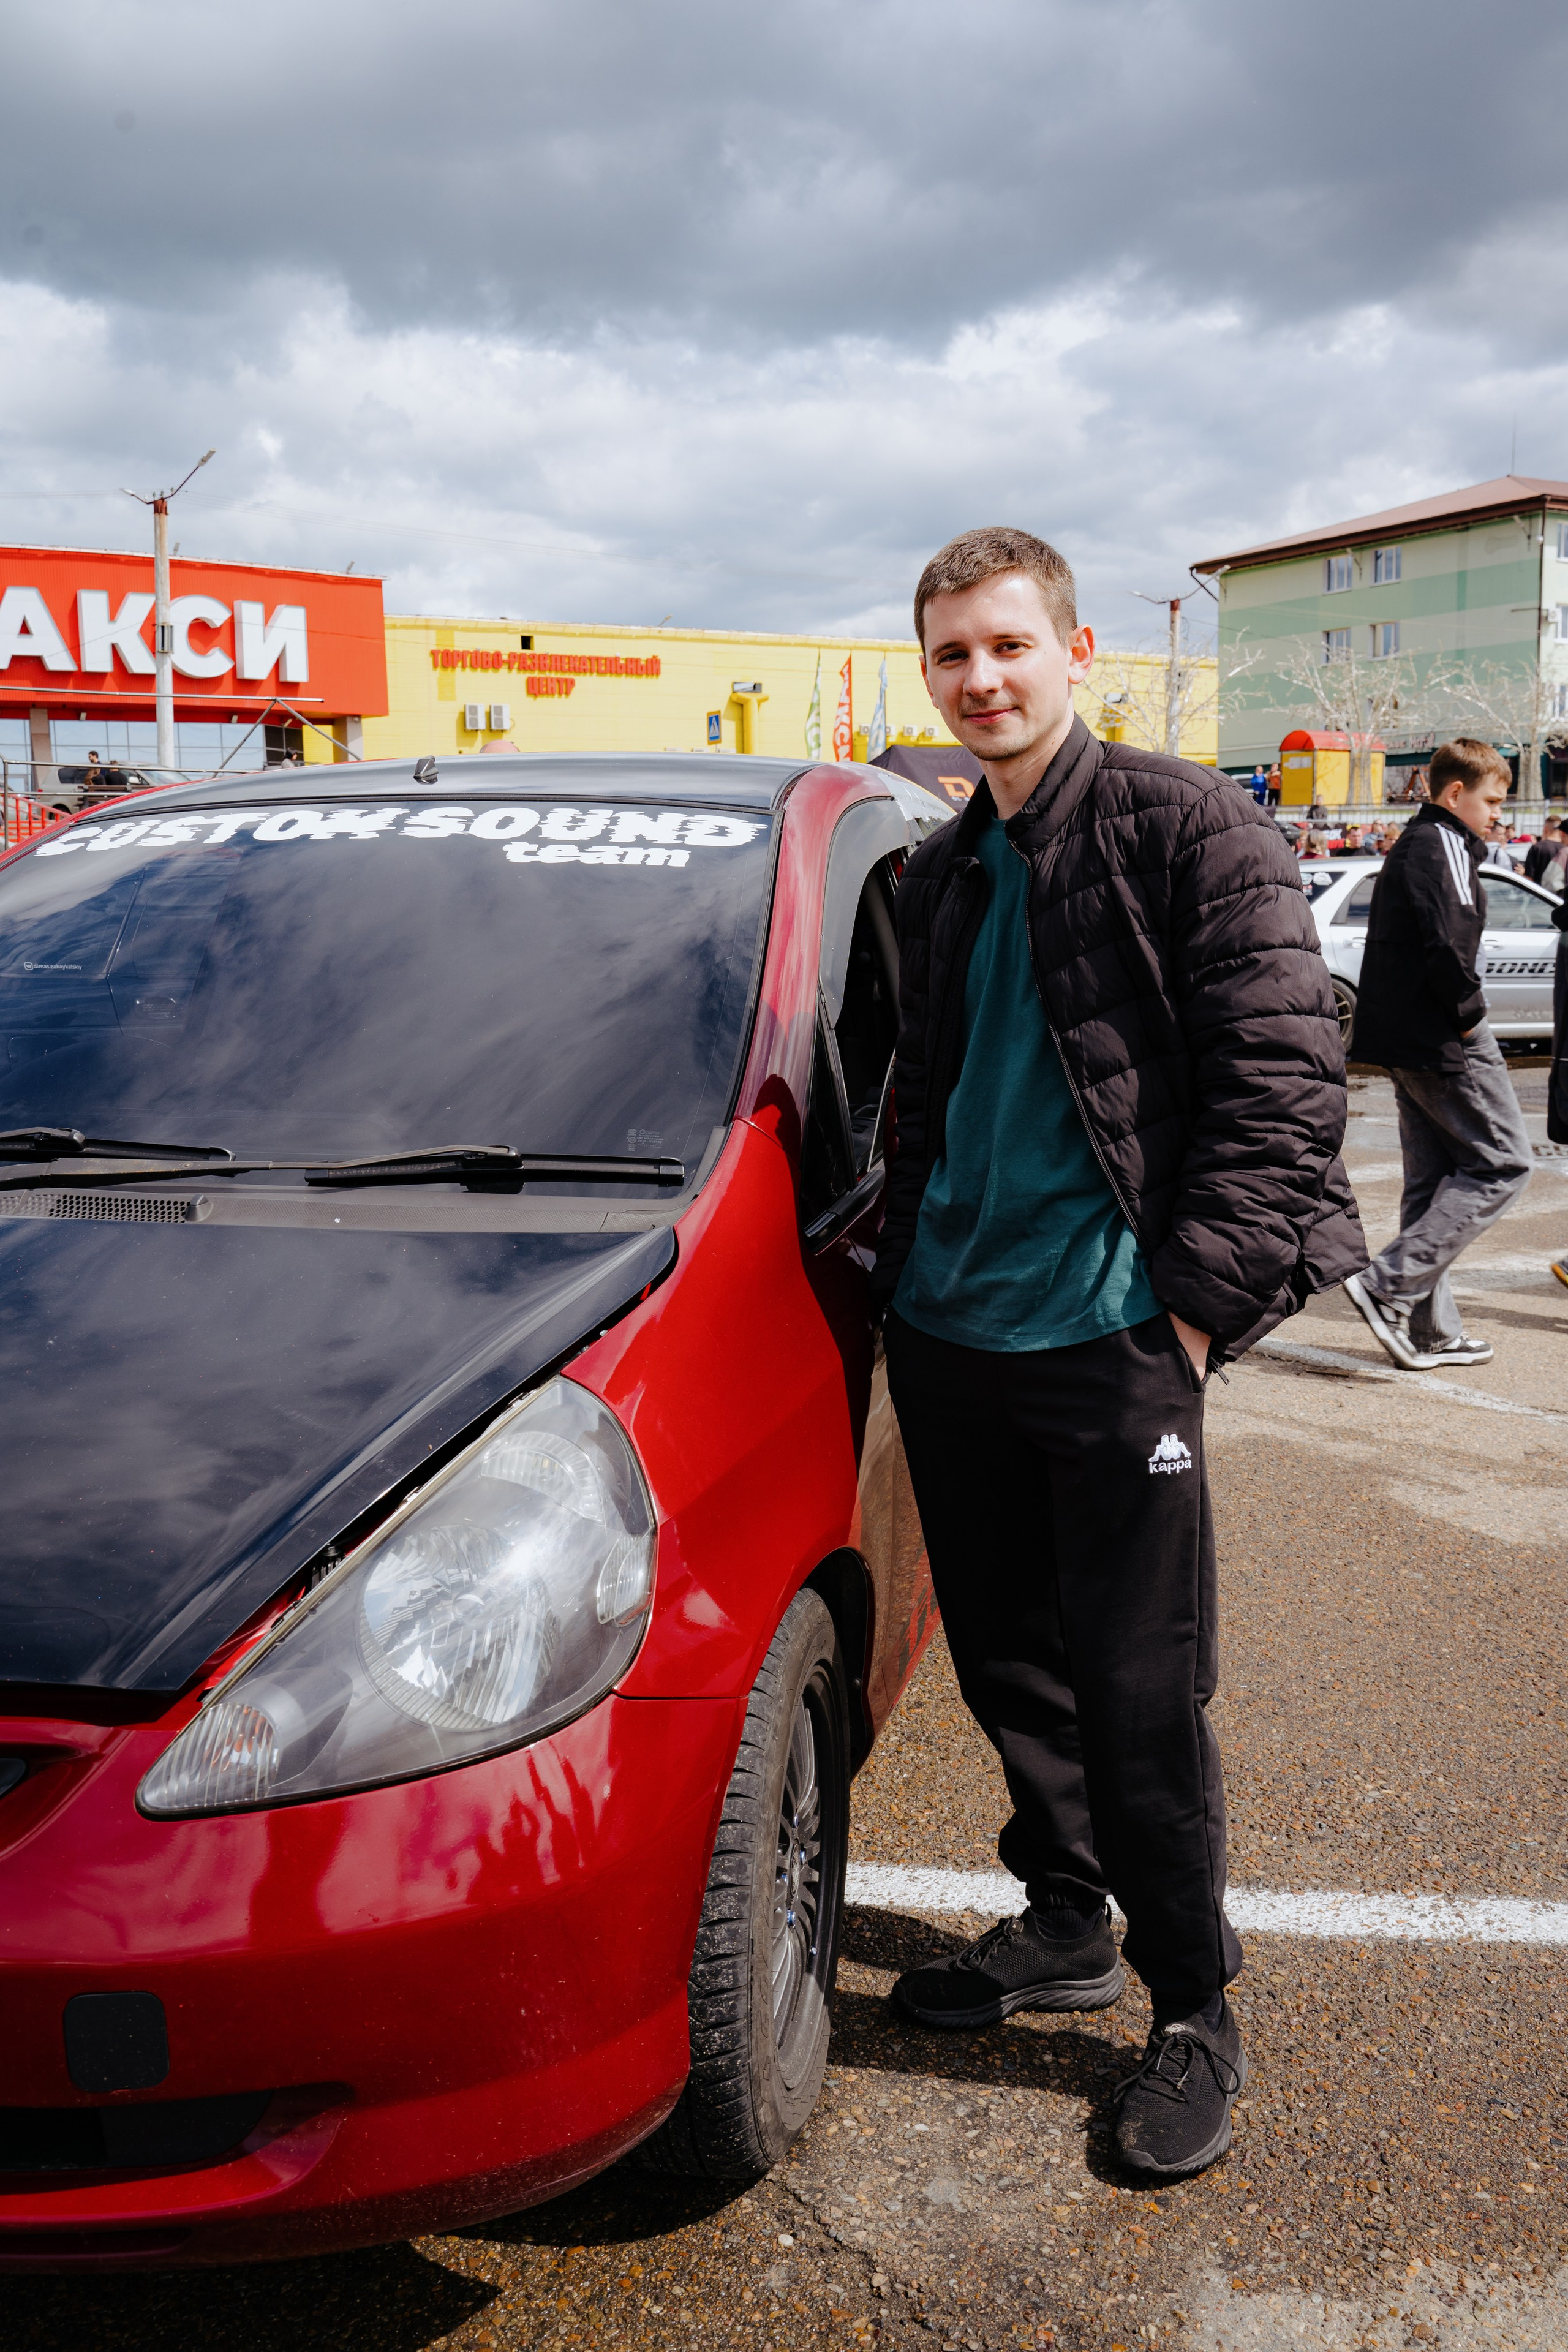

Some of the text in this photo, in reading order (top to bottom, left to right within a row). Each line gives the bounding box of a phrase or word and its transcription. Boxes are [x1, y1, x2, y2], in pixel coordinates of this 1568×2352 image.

[431, 649, 661, 676] ТОРГОВО-РАЗВЛЕКАТЕЛЬНЫЙ
[527, 677, 575, 698] ЦЕНТР
[398, 807, 769, 847] SOUND
[503, 841, 692, 868] team
